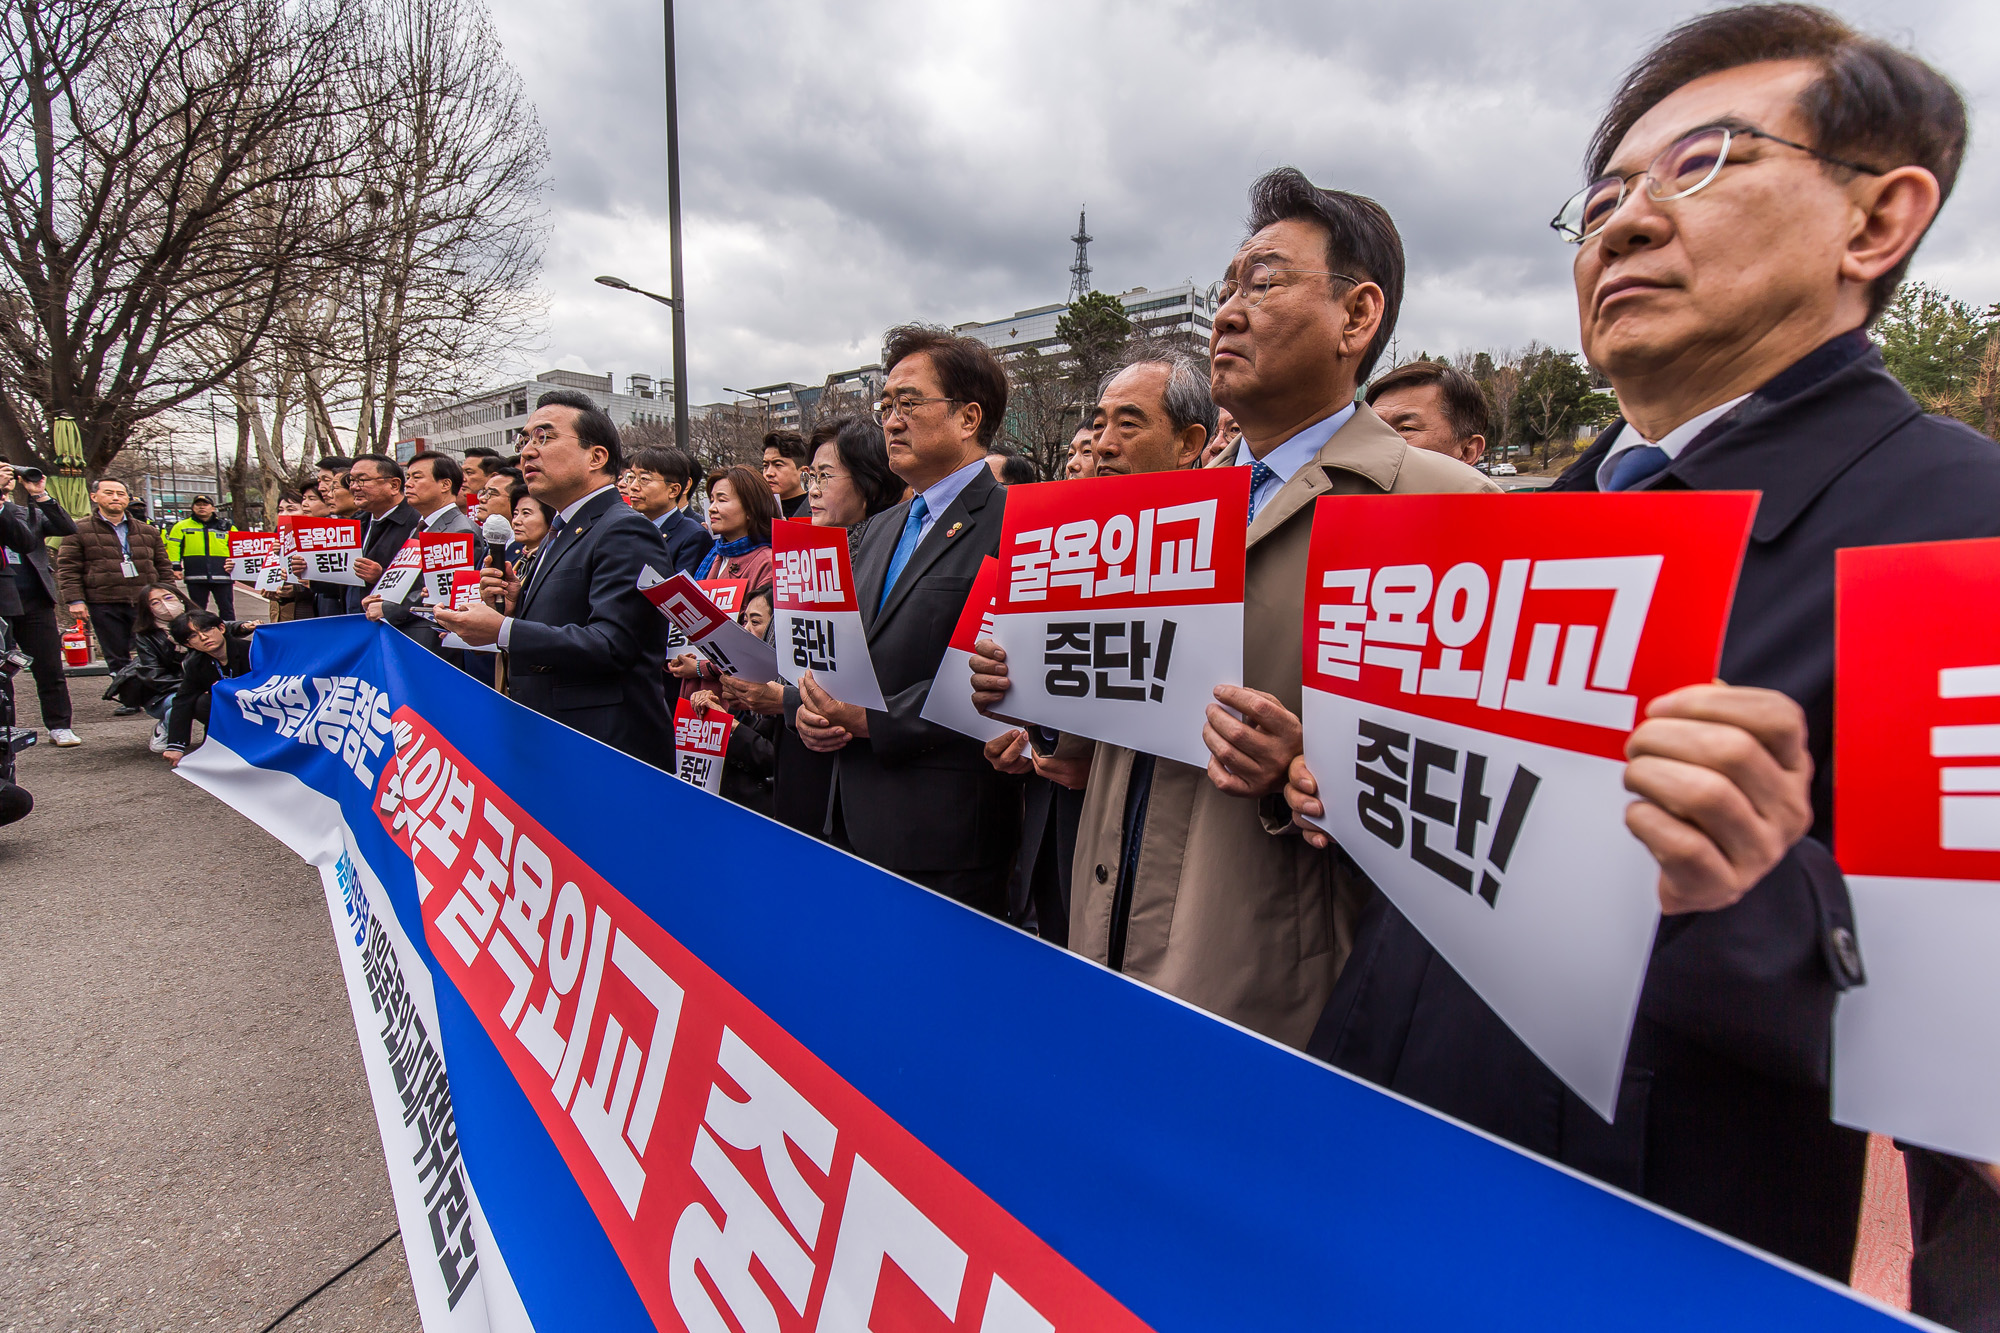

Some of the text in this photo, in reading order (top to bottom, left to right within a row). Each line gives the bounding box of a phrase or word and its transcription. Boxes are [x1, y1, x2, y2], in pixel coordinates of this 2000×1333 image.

[298, 525, 356, 550] 굴욕외교
[315, 552, 349, 573] 중단!
[423, 540, 468, 570] 굴욕외교
[1009, 499, 1218, 602] 굴욕외교
[378, 570, 407, 591] 중단!
[774, 546, 846, 603] 굴욕외교
[790, 616, 838, 672] 중단!
[1044, 618, 1178, 704] 중단!
[1315, 553, 1665, 732] 굴욕외교
[234, 674, 394, 790] 윤석열 대통령은
[675, 717, 727, 752] 굴욕외교
[680, 754, 713, 788] 중단!
[1353, 718, 1542, 910] 중단!
[435, 797, 685, 1221] 굴욕외교
